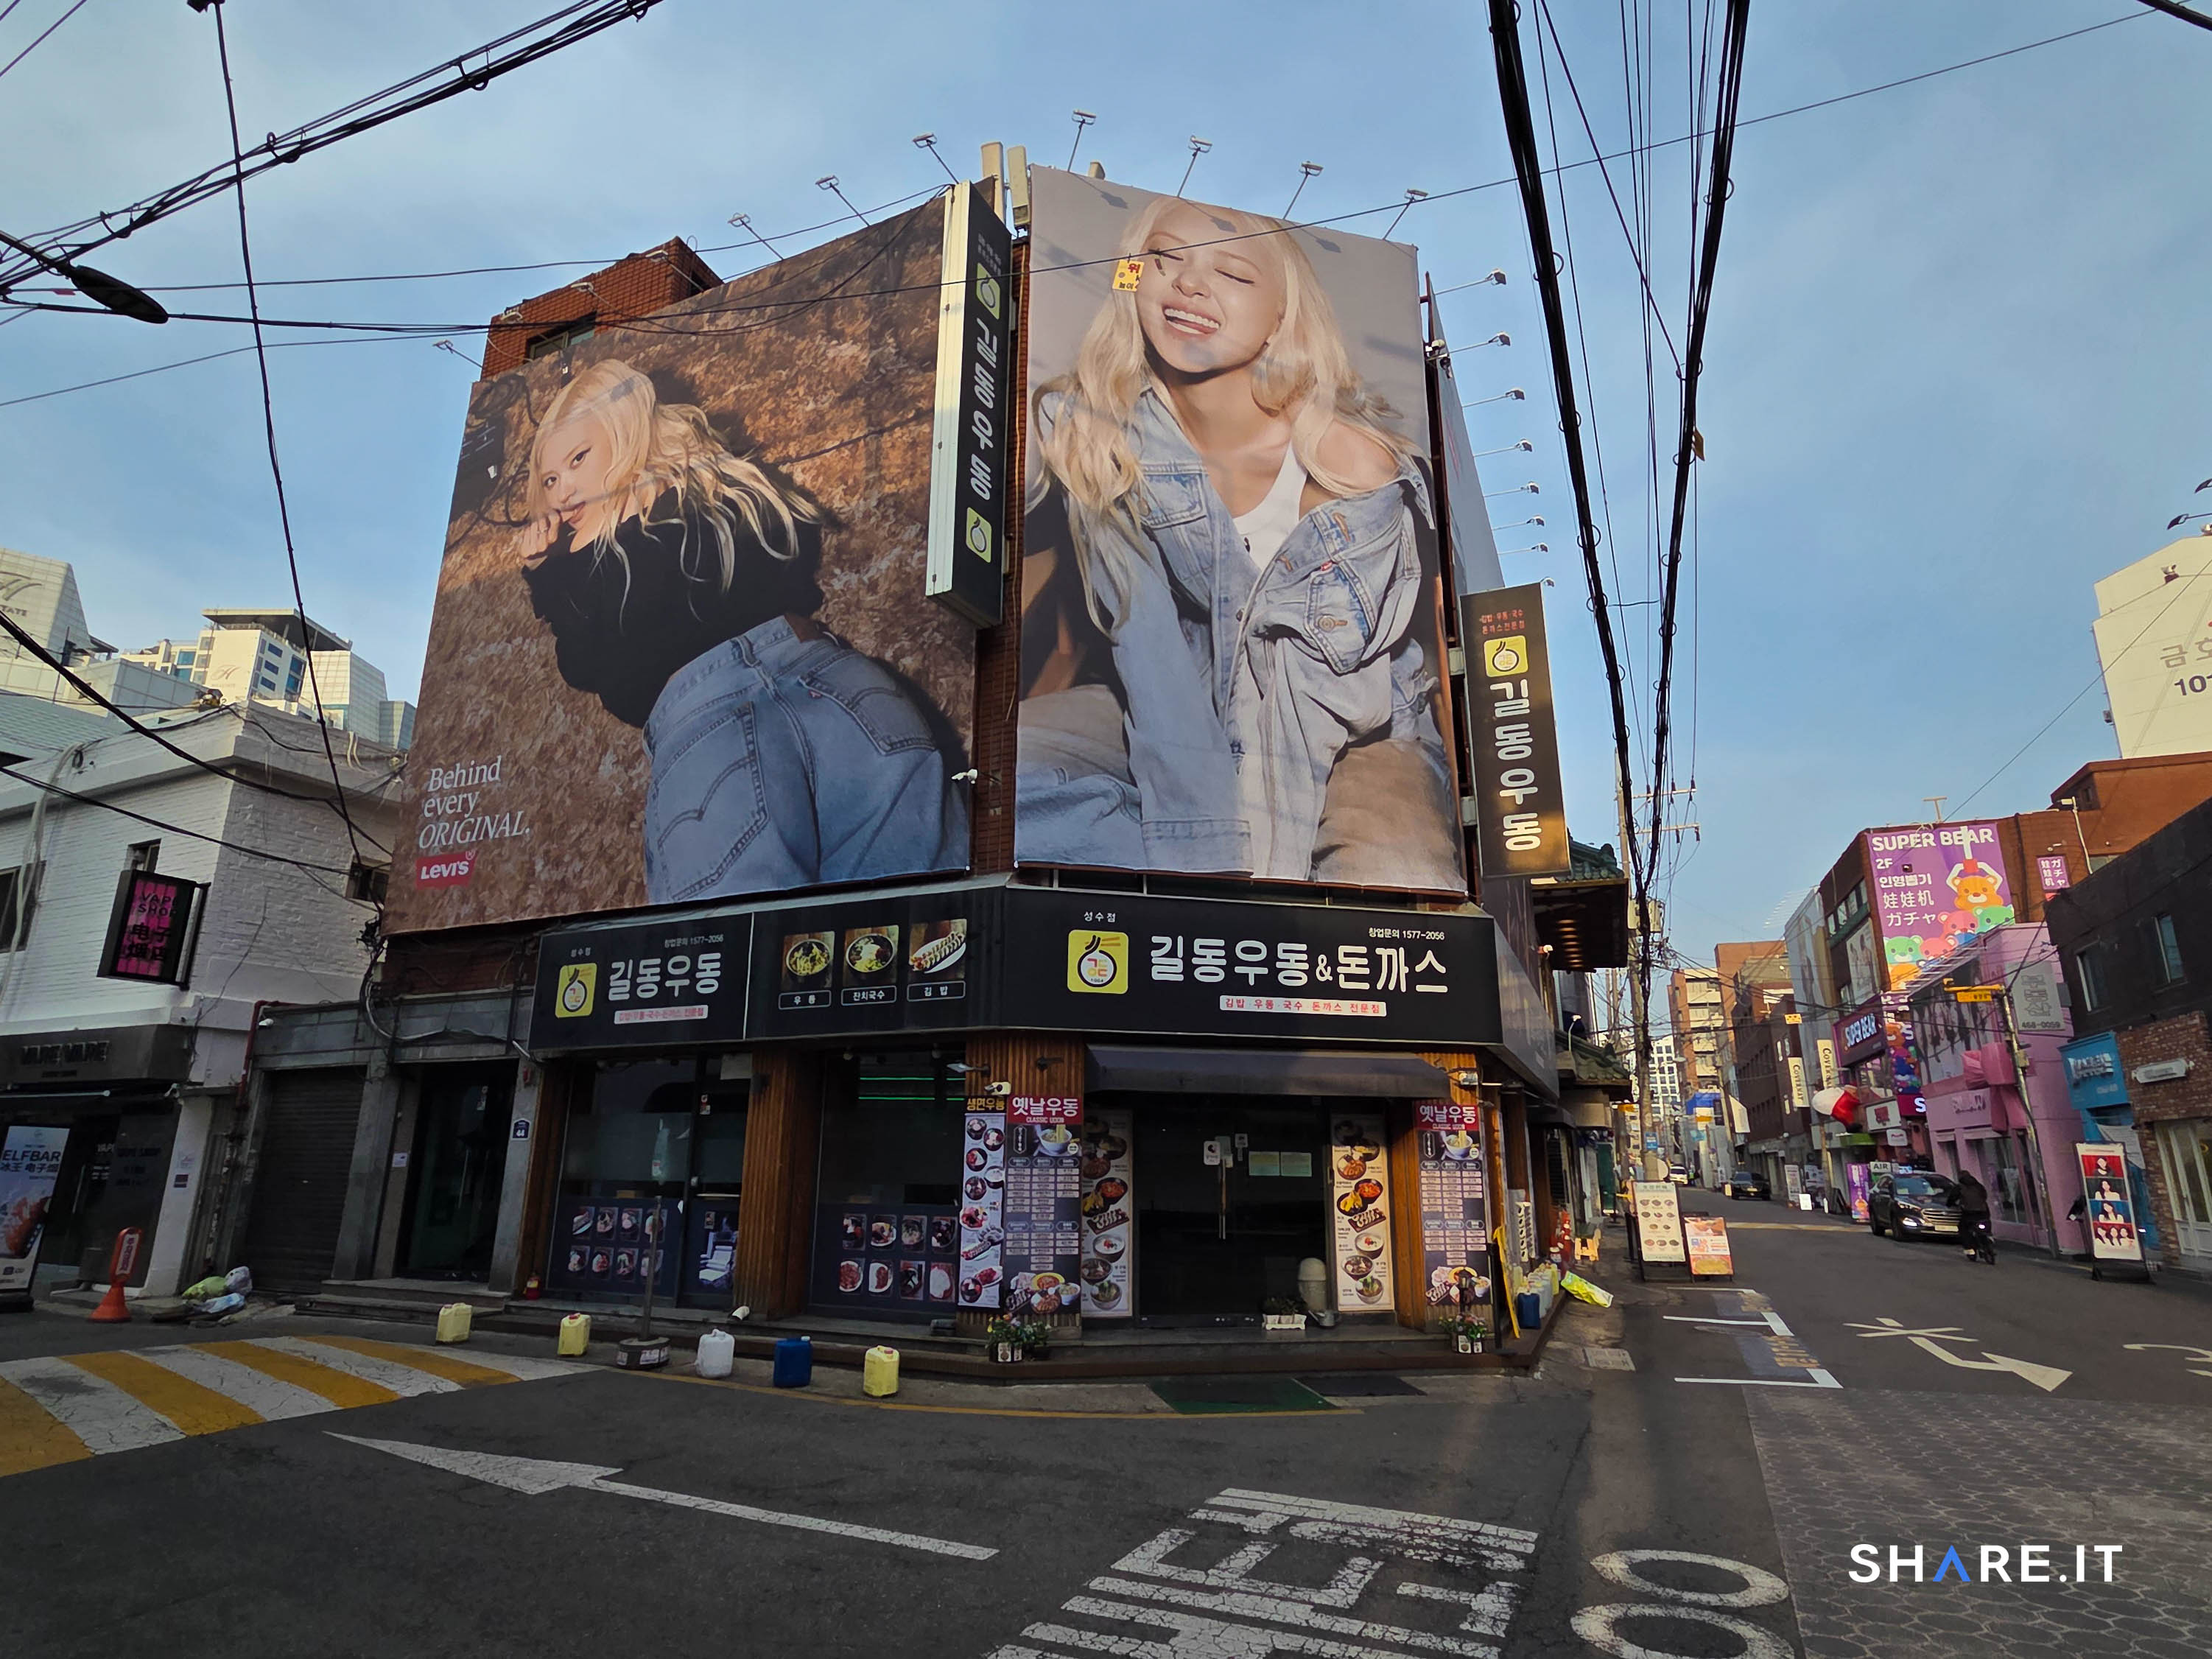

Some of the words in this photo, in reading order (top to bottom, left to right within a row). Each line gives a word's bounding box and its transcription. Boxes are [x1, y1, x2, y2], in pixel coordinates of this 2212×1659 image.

[971, 318, 997, 501] 길동우동
[2174, 674, 2212, 696] 10
[427, 754, 502, 793] Behind
[1490, 678, 1542, 852] 길동우동
[424, 791, 480, 818] every
[418, 810, 530, 849] ORIGINAL.
[1872, 832, 1936, 852] SUPER
[1939, 828, 1995, 846] BEAR
[1876, 858, 1893, 869] 2F
[2051, 858, 2065, 886] ガチャ
[1879, 873, 1932, 888] 인형뽑기
[1883, 890, 1934, 909] 娃娃机
[1084, 911, 1116, 922] 성수점
[1886, 913, 1936, 927] ガチャ
[1369, 927, 1400, 939] 창업문의
[1402, 930, 1445, 941] 1577-2056
[608, 953, 722, 1001] 길동우동
[853, 989, 885, 1001] 잔치국수
[1225, 998, 1245, 1009] 김밥
[1254, 999, 1274, 1011] 우동
[1283, 1000, 1303, 1011] 국수
[1312, 1001, 1343, 1012] 돈까스
[1349, 1003, 1380, 1014] 전문점
[966, 1098, 1005, 1111] 생면우동
[1012, 1097, 1079, 1117] 옛날우동
[1419, 1105, 1476, 1123] 옛날우동
[2, 1150, 61, 1162] ELFBAR
